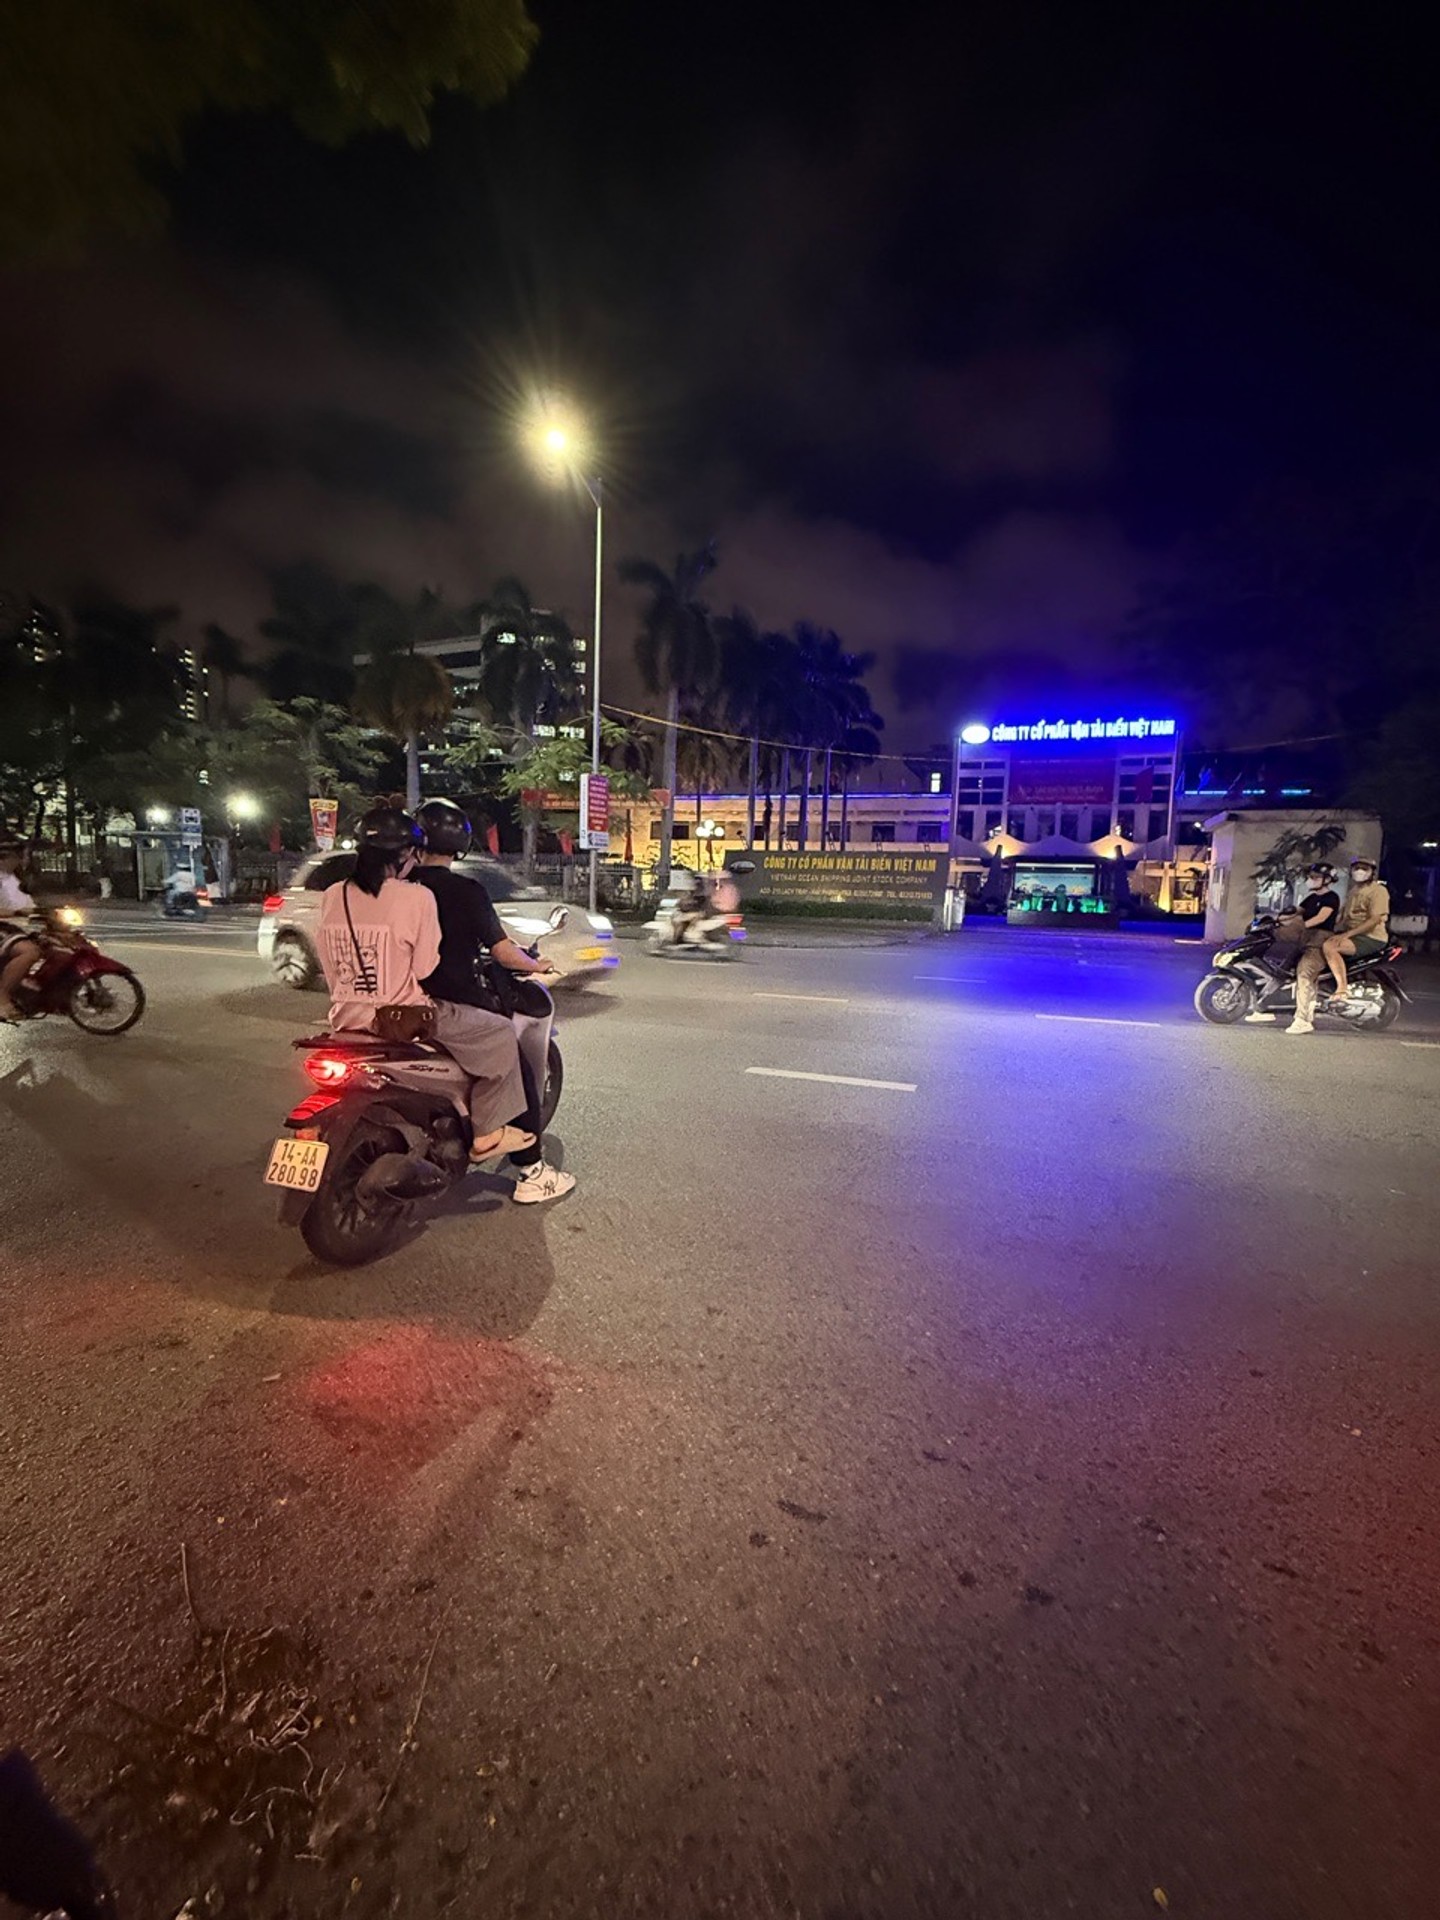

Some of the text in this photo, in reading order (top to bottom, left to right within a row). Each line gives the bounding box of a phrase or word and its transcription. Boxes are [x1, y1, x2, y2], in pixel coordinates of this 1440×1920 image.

[787, 857, 798, 870] TY
[915, 859, 937, 872] NAM
[281, 1142, 318, 1166] 14-AA
[268, 1162, 318, 1188] 280.98
